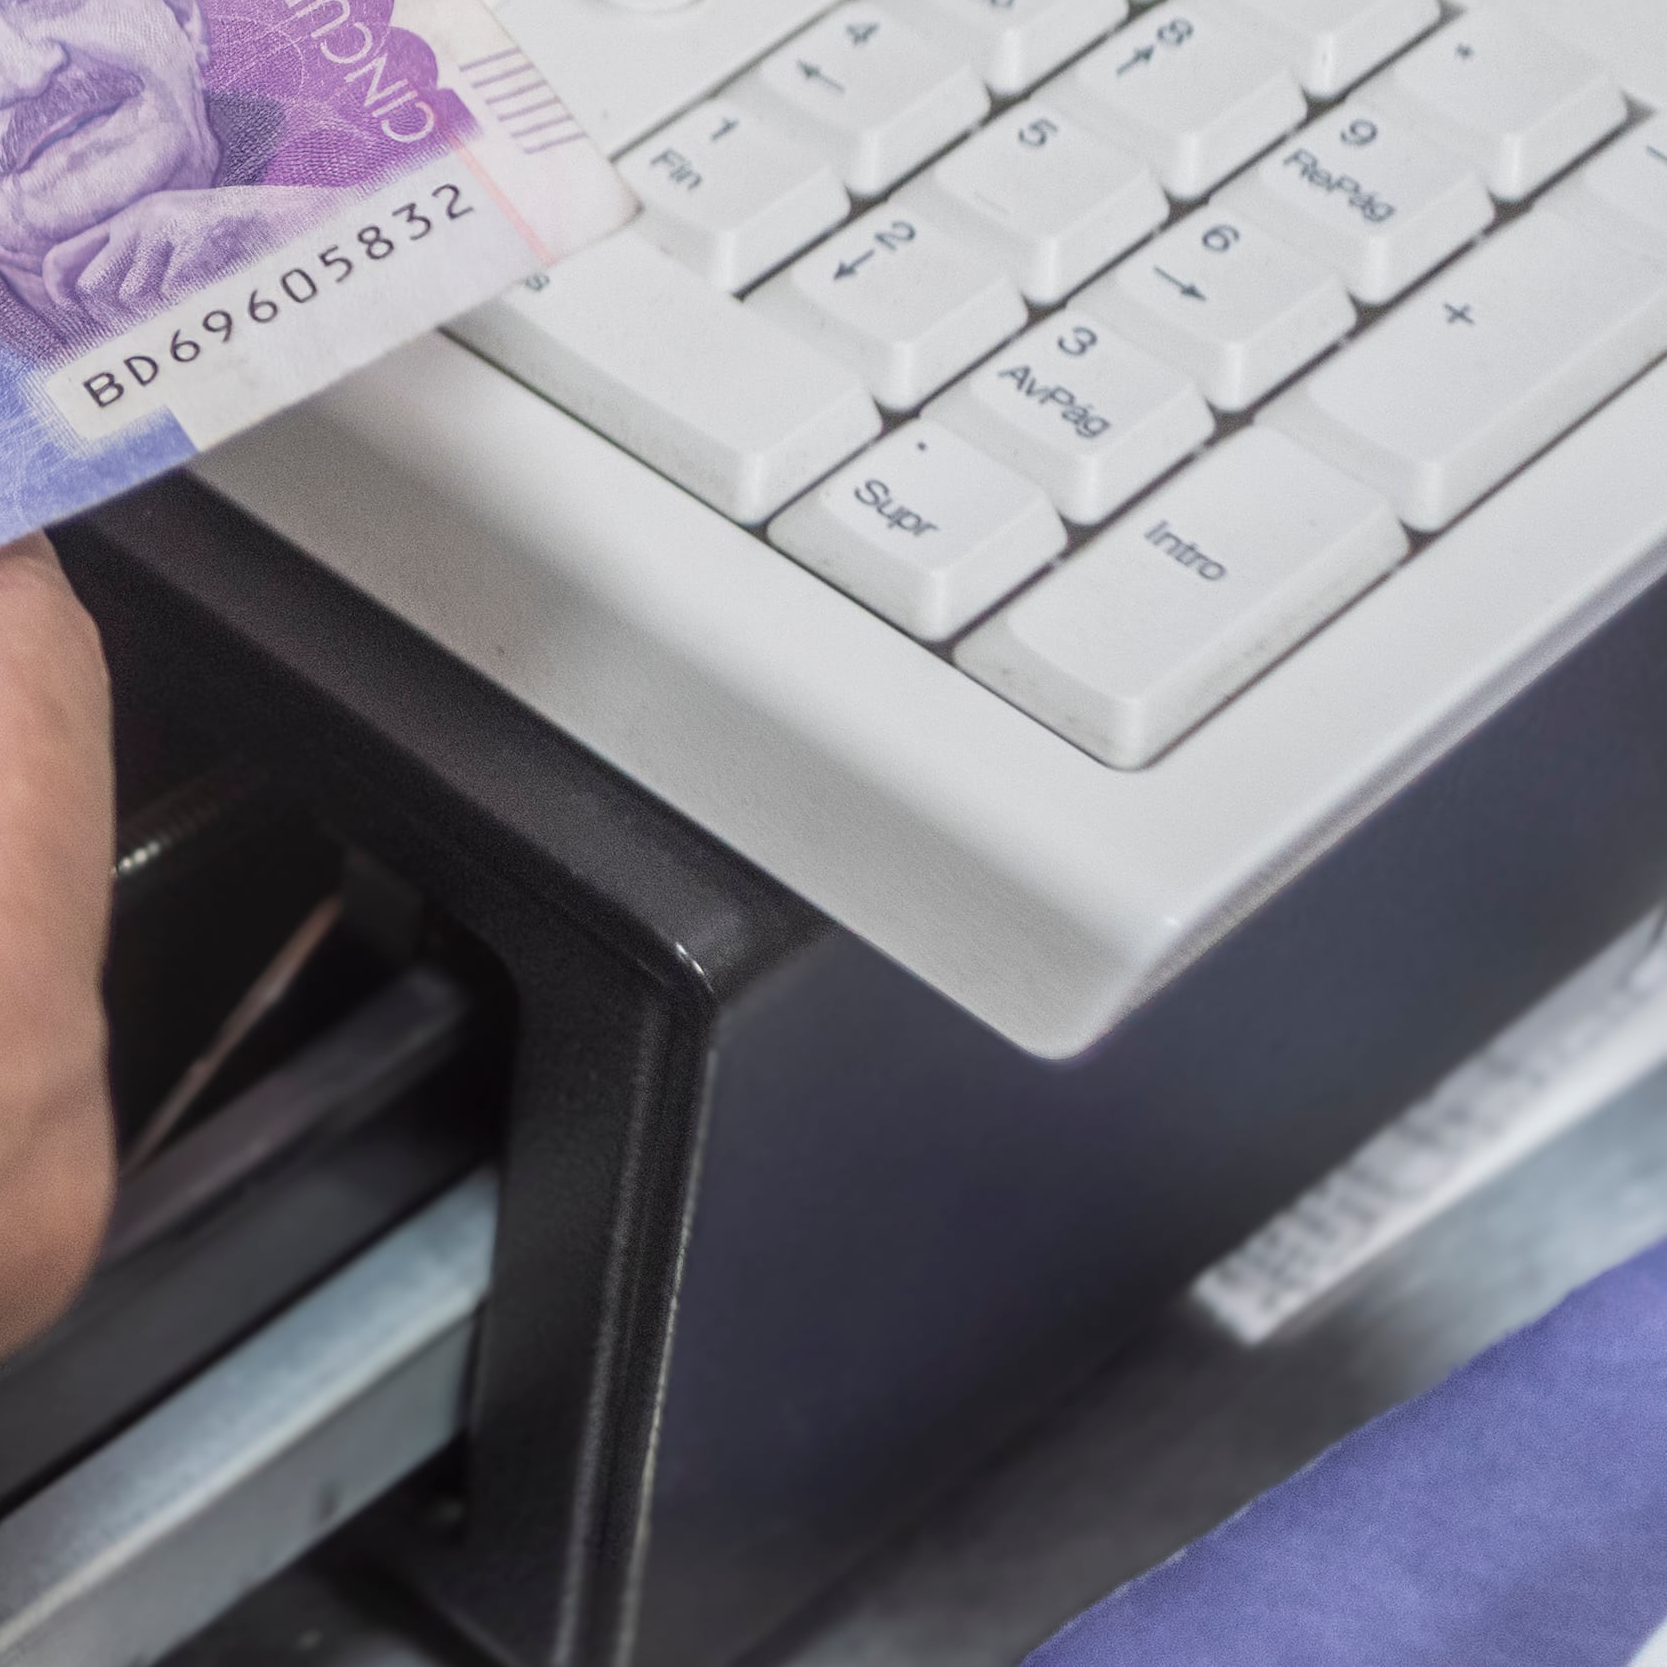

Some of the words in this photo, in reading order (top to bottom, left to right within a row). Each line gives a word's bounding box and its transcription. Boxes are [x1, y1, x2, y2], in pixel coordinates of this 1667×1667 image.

[845, 22, 881, 46] 4
[1156, 16, 1194, 47] 8
[710, 116, 739, 142] 1
[1018, 117, 1059, 149] 5
[1340, 118, 1378, 147] 9
[650, 148, 703, 190] Fin
[873, 220, 917, 252] 2
[1201, 224, 1240, 253] 6
[82, 182, 475, 409] BD69605832
[1057, 326, 1098, 357] 3
[997, 364, 1110, 439] AvPág
[854, 479, 939, 537] Supr
[1143, 520, 1227, 581] Intro
